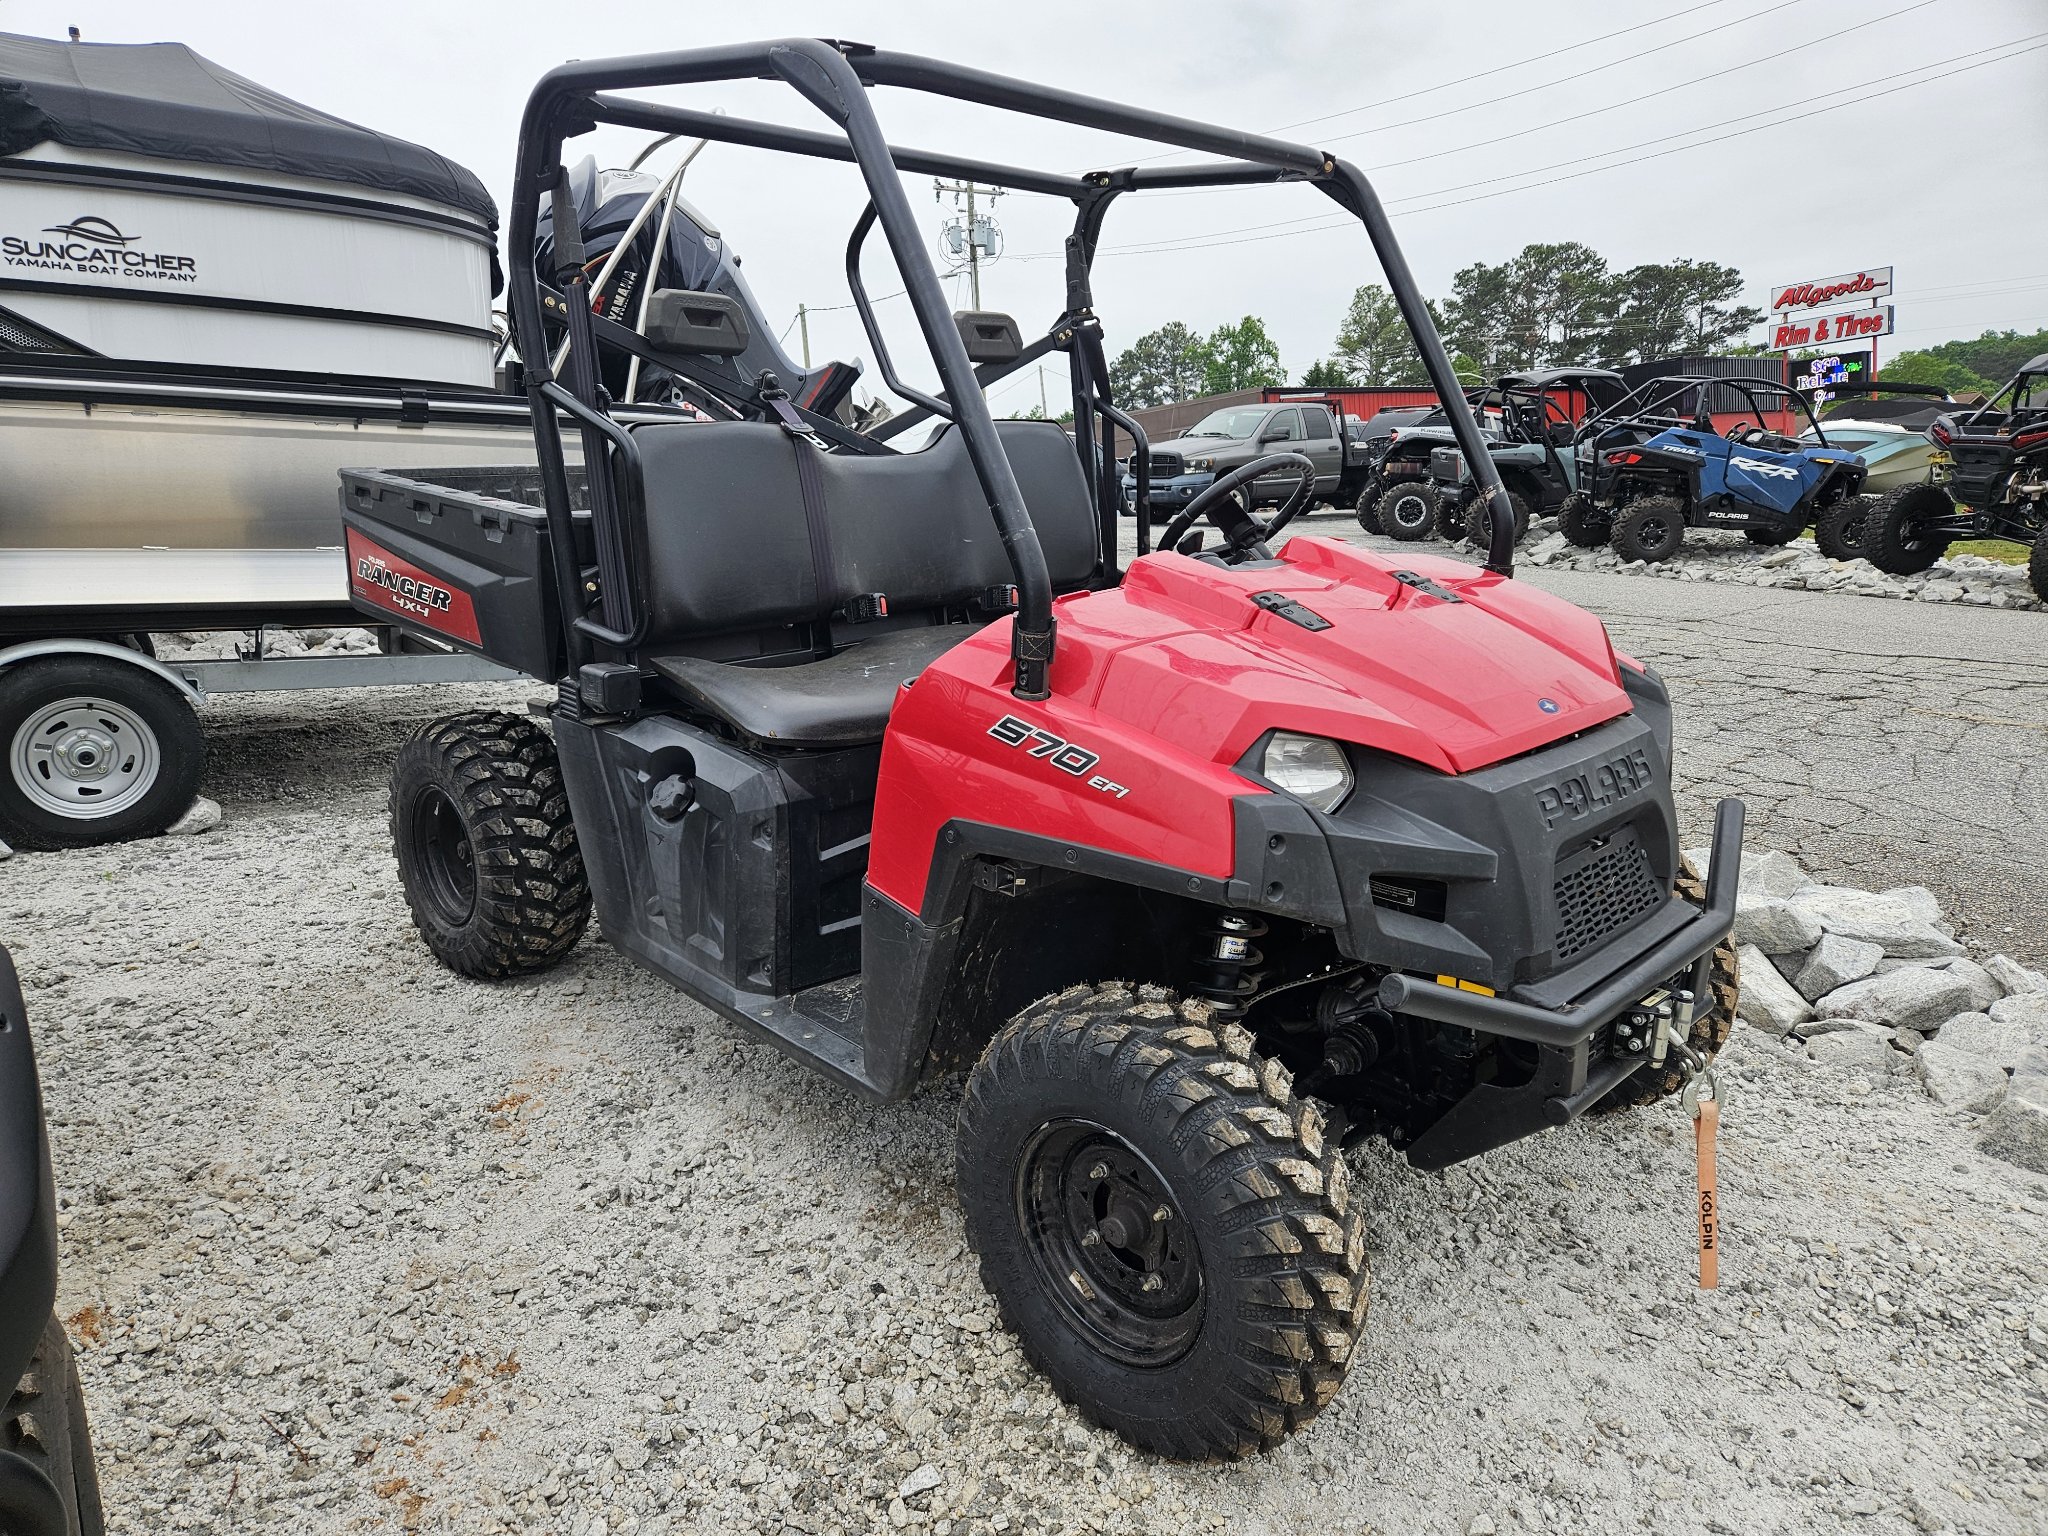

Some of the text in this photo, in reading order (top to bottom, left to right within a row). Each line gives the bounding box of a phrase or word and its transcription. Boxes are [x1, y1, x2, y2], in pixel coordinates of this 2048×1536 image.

[4, 256, 197, 282] YAMAHA BOAT COMPANY
[607, 270, 638, 321] YAMAHA
[1773, 273, 1889, 309] Allgoods
[1774, 314, 1884, 349] Rim & Tires
[1729, 456, 1799, 481] RZR
[1708, 511, 1750, 520] POLARIS
[357, 557, 452, 612] RANGER
[986, 714, 1131, 799] 570 EFI
[1535, 749, 1654, 832] POLARIS
[1701, 1190, 1714, 1250] KOLPIN
